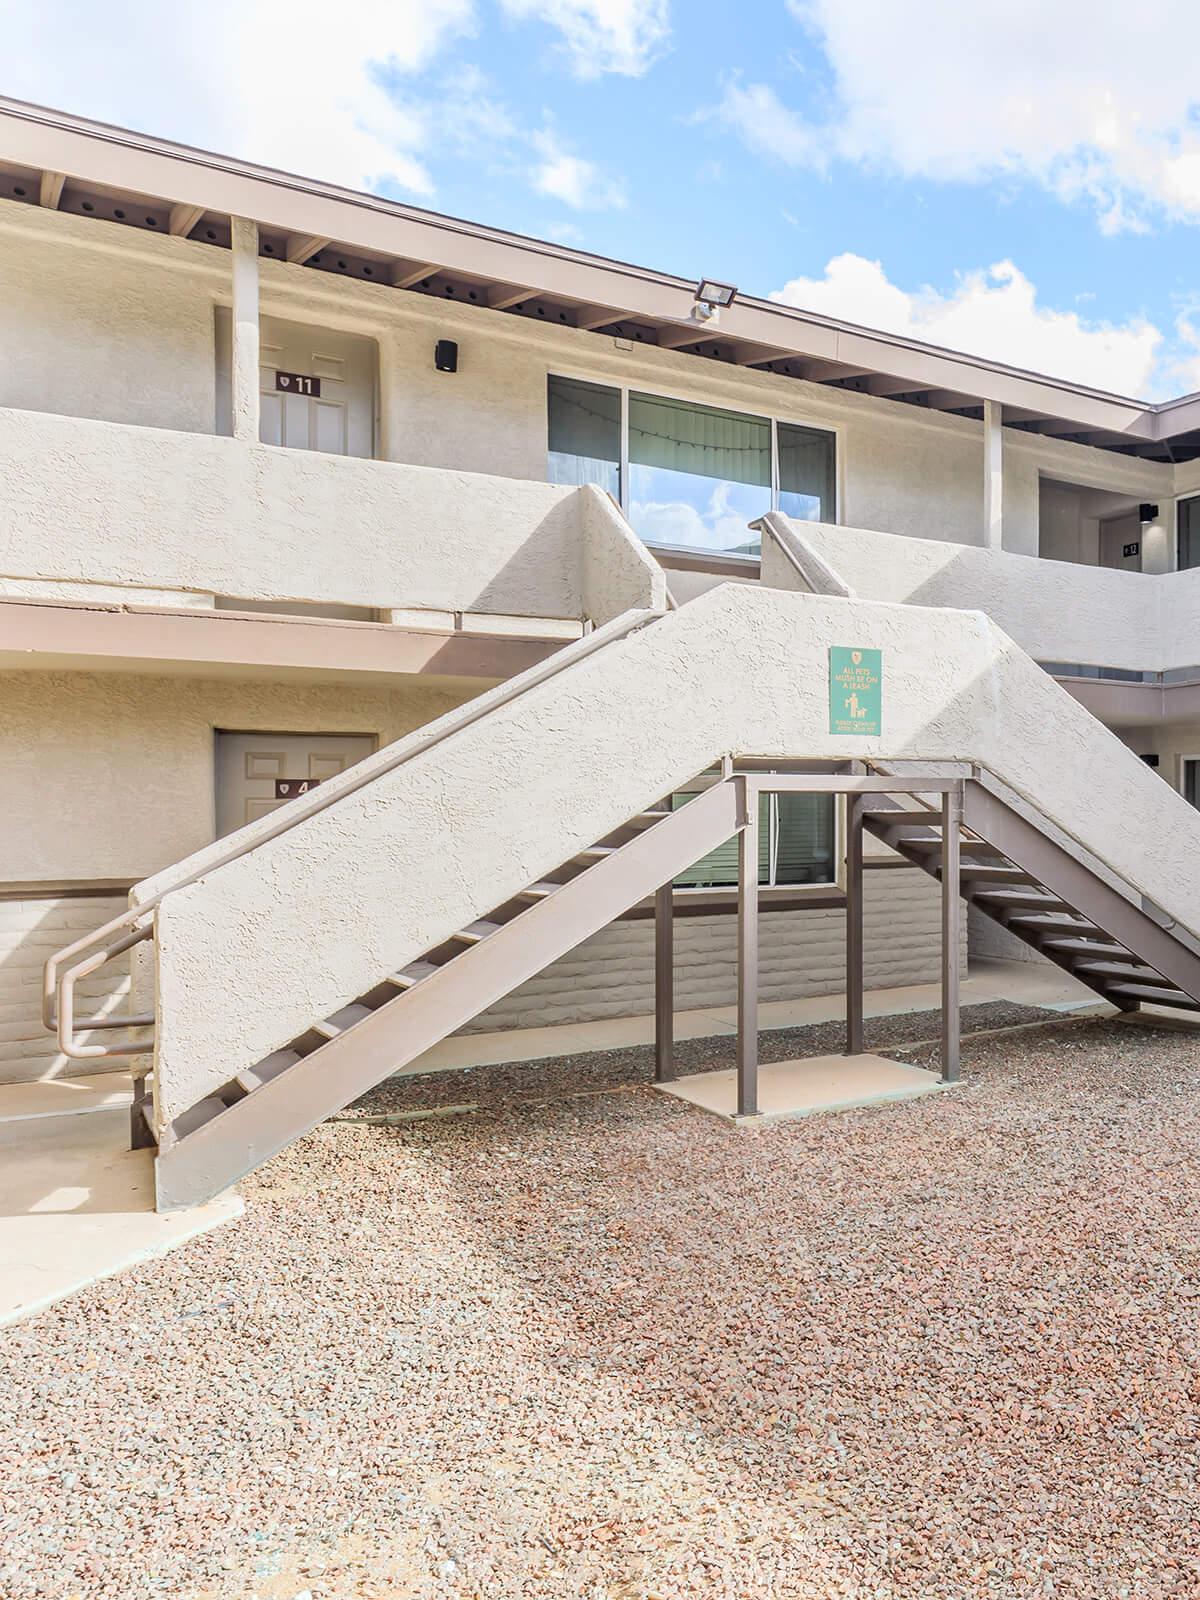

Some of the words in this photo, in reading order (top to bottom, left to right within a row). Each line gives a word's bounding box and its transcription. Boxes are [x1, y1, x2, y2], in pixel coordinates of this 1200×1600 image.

[295, 377, 312, 394] 11
[843, 666, 854, 674] ALL
[298, 781, 309, 793] 4
